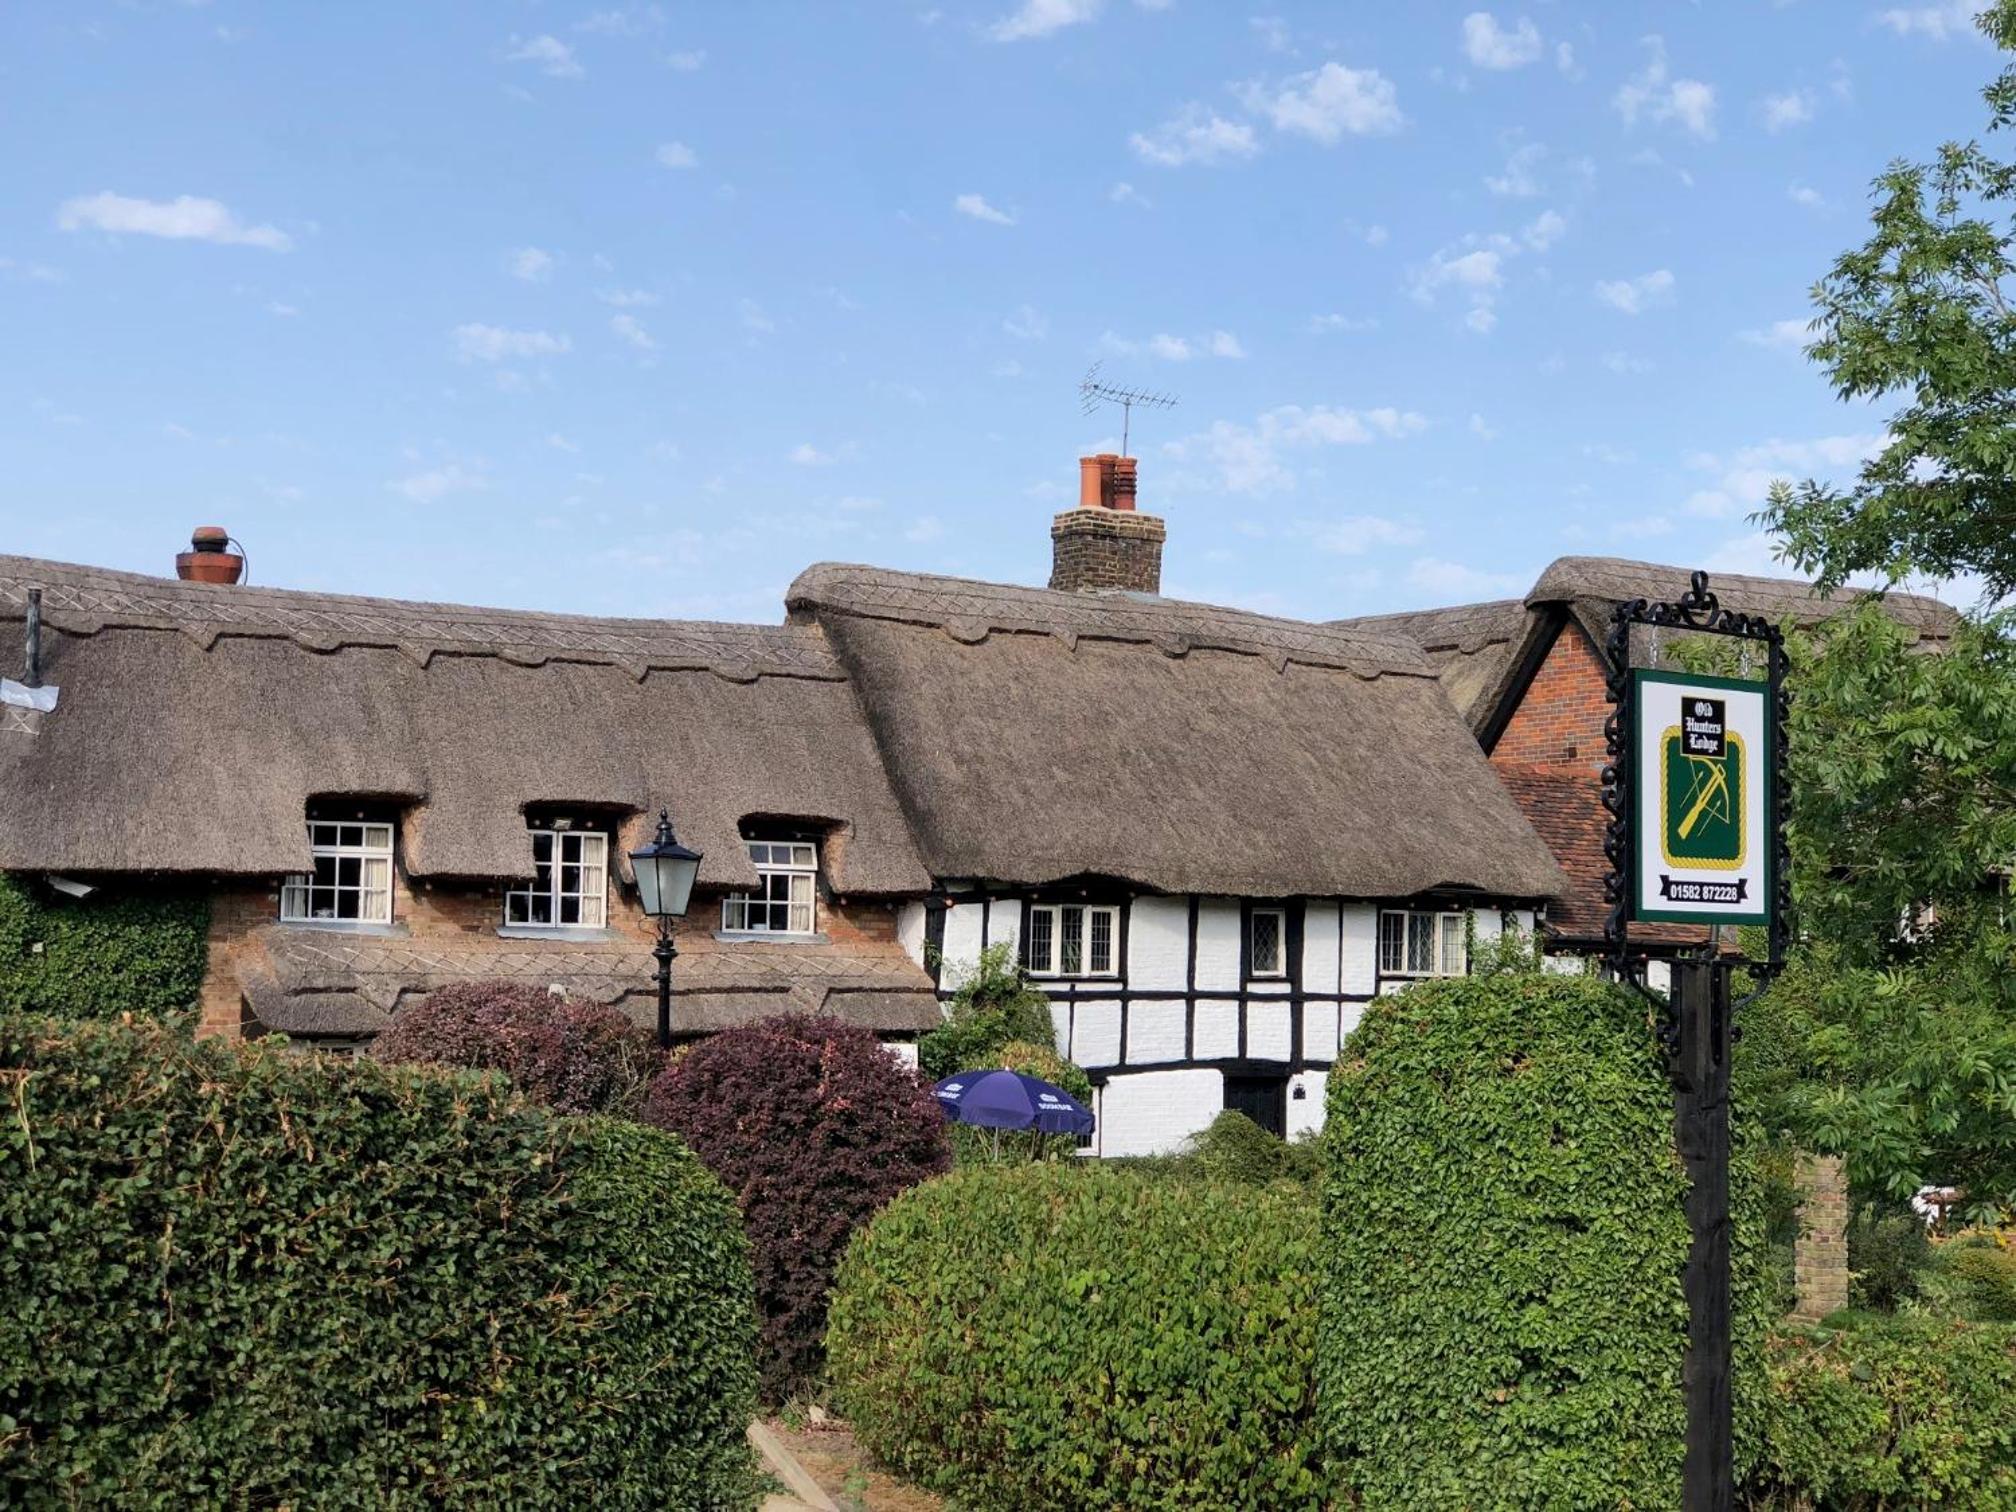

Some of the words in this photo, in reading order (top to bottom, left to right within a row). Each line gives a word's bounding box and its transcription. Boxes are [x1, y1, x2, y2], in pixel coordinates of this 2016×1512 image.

[1695, 701, 1713, 717] Old
[1685, 717, 1722, 734] Hunters
[1690, 733, 1718, 753] Lodge
[1670, 884, 1700, 899] 01582
[1702, 885, 1738, 901] 872228
